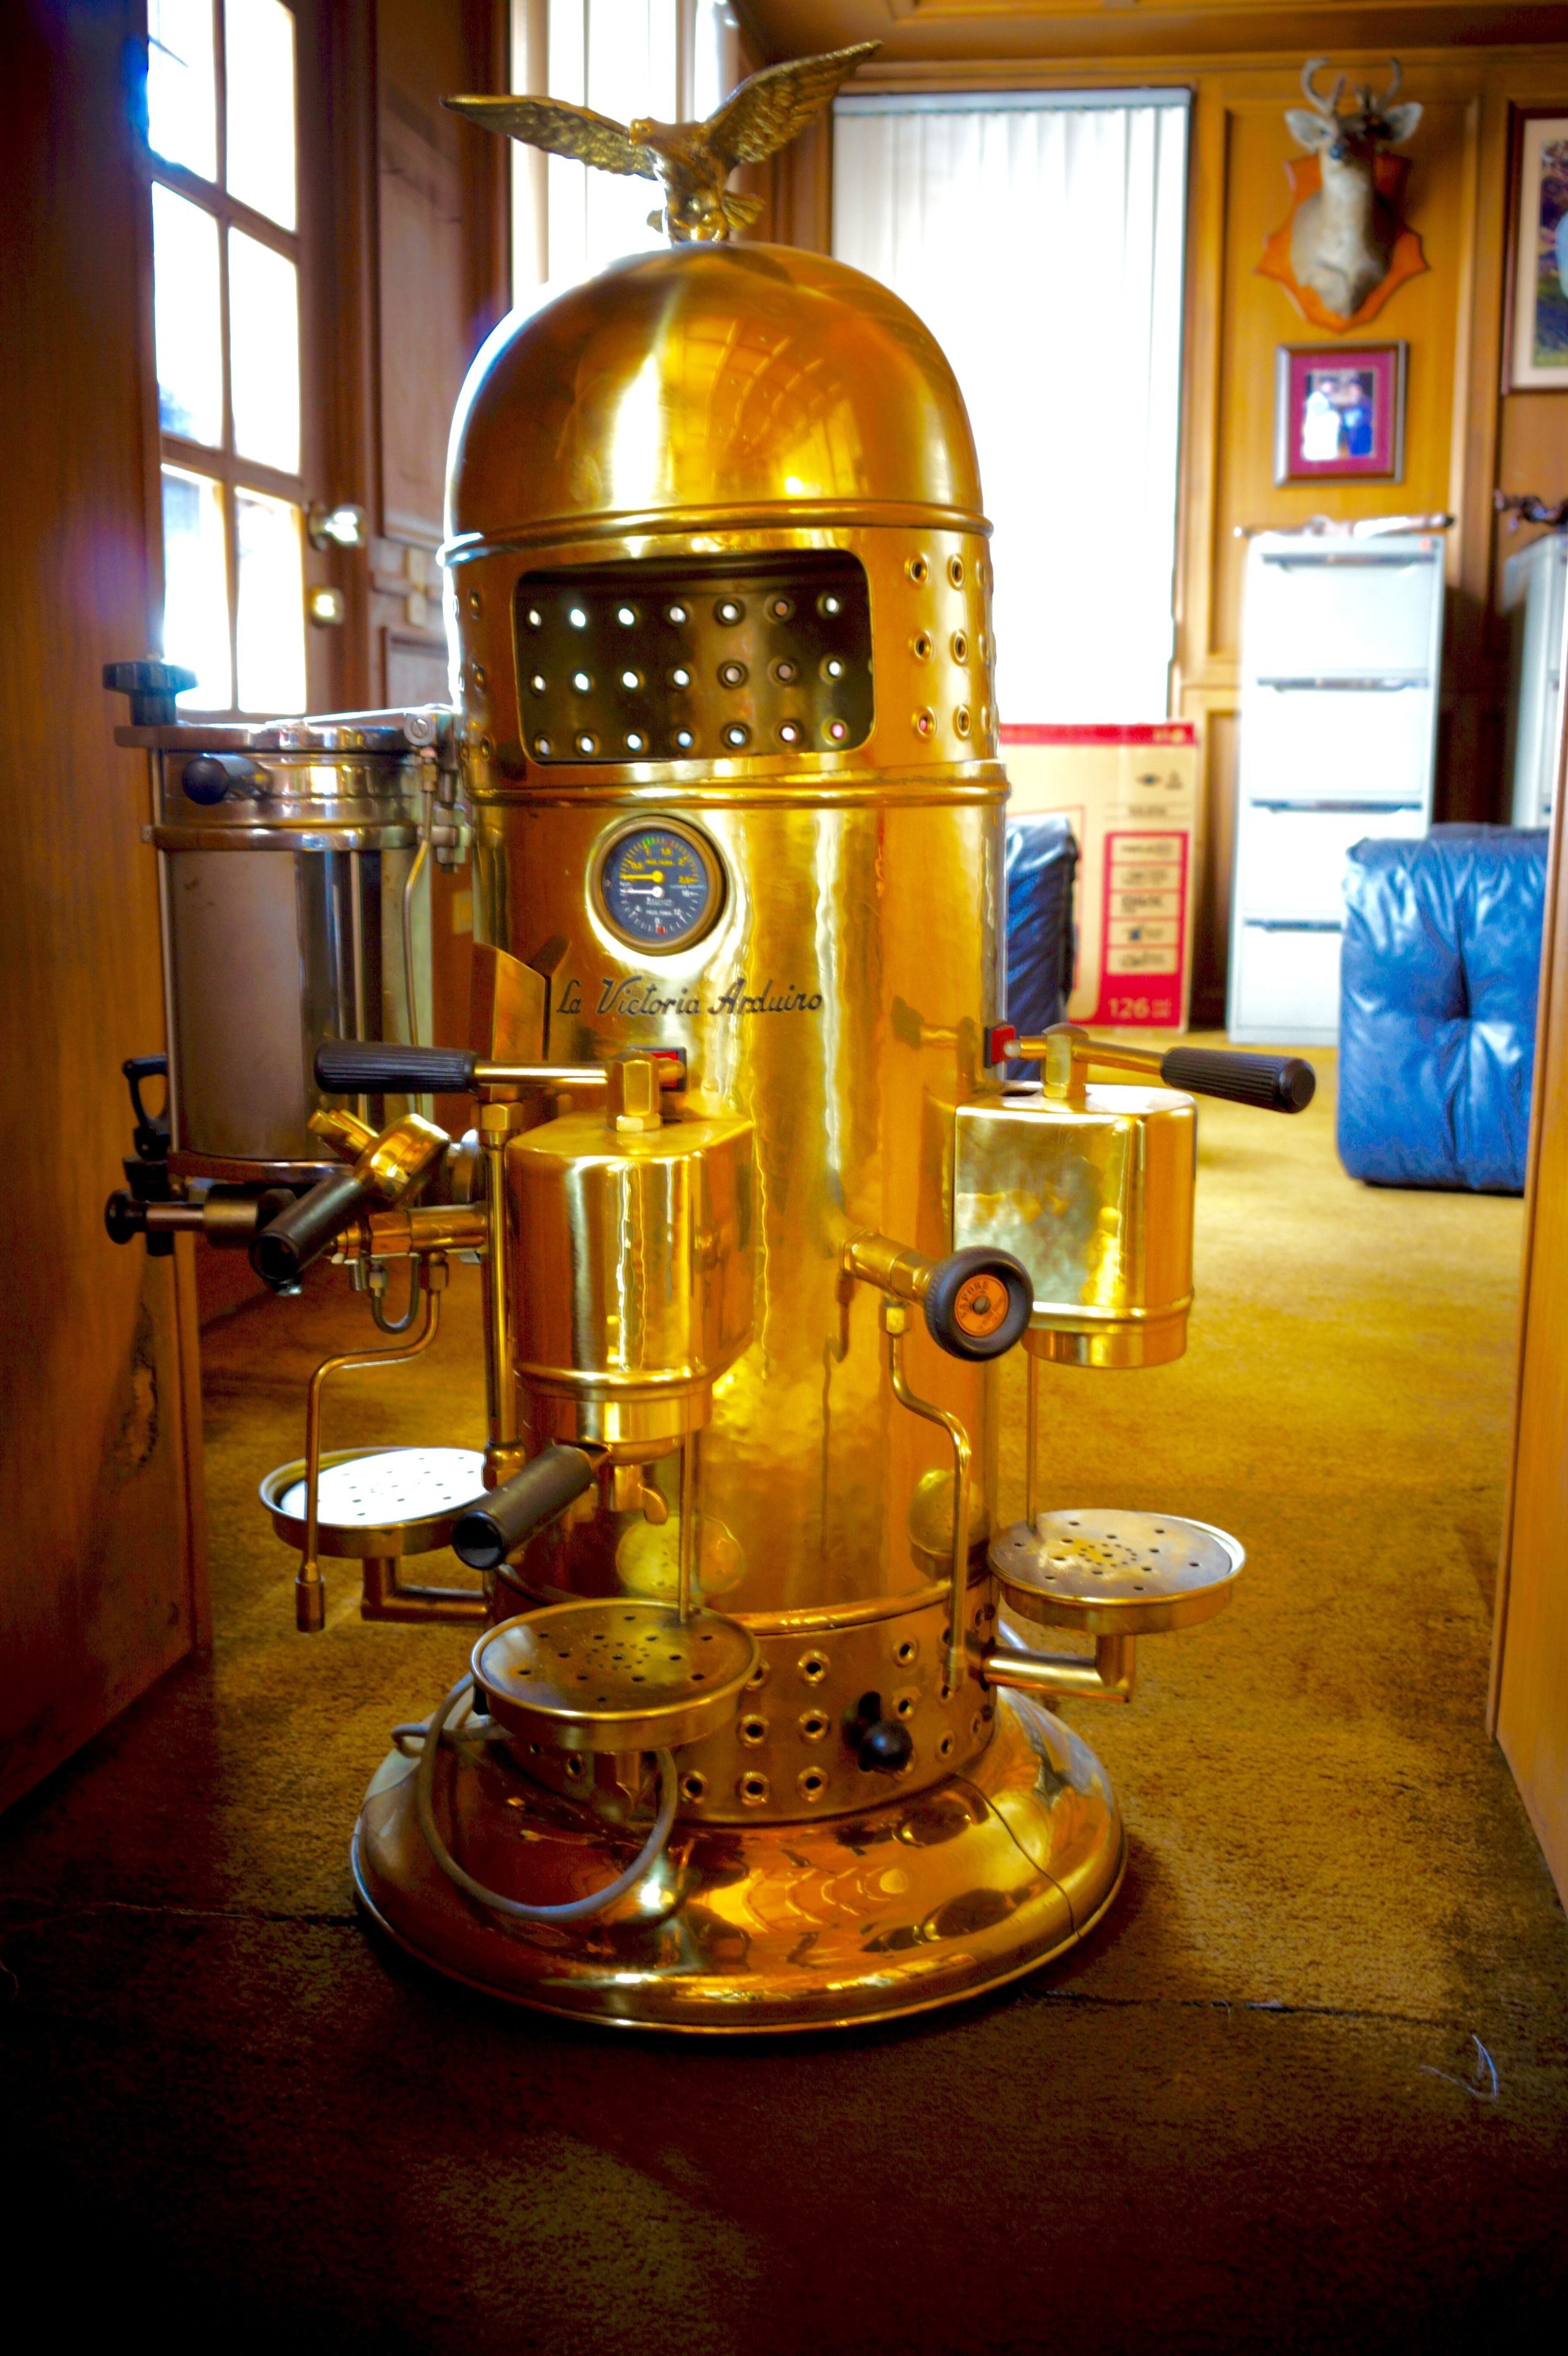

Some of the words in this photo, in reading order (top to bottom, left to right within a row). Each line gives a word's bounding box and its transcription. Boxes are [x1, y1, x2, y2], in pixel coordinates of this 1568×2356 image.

[556, 979, 582, 1014] La
[596, 976, 701, 1015] Victoria
[707, 978, 823, 1015] Arduino
[1108, 996, 1150, 1019] 126
[959, 1280, 988, 1319] VAPORE
